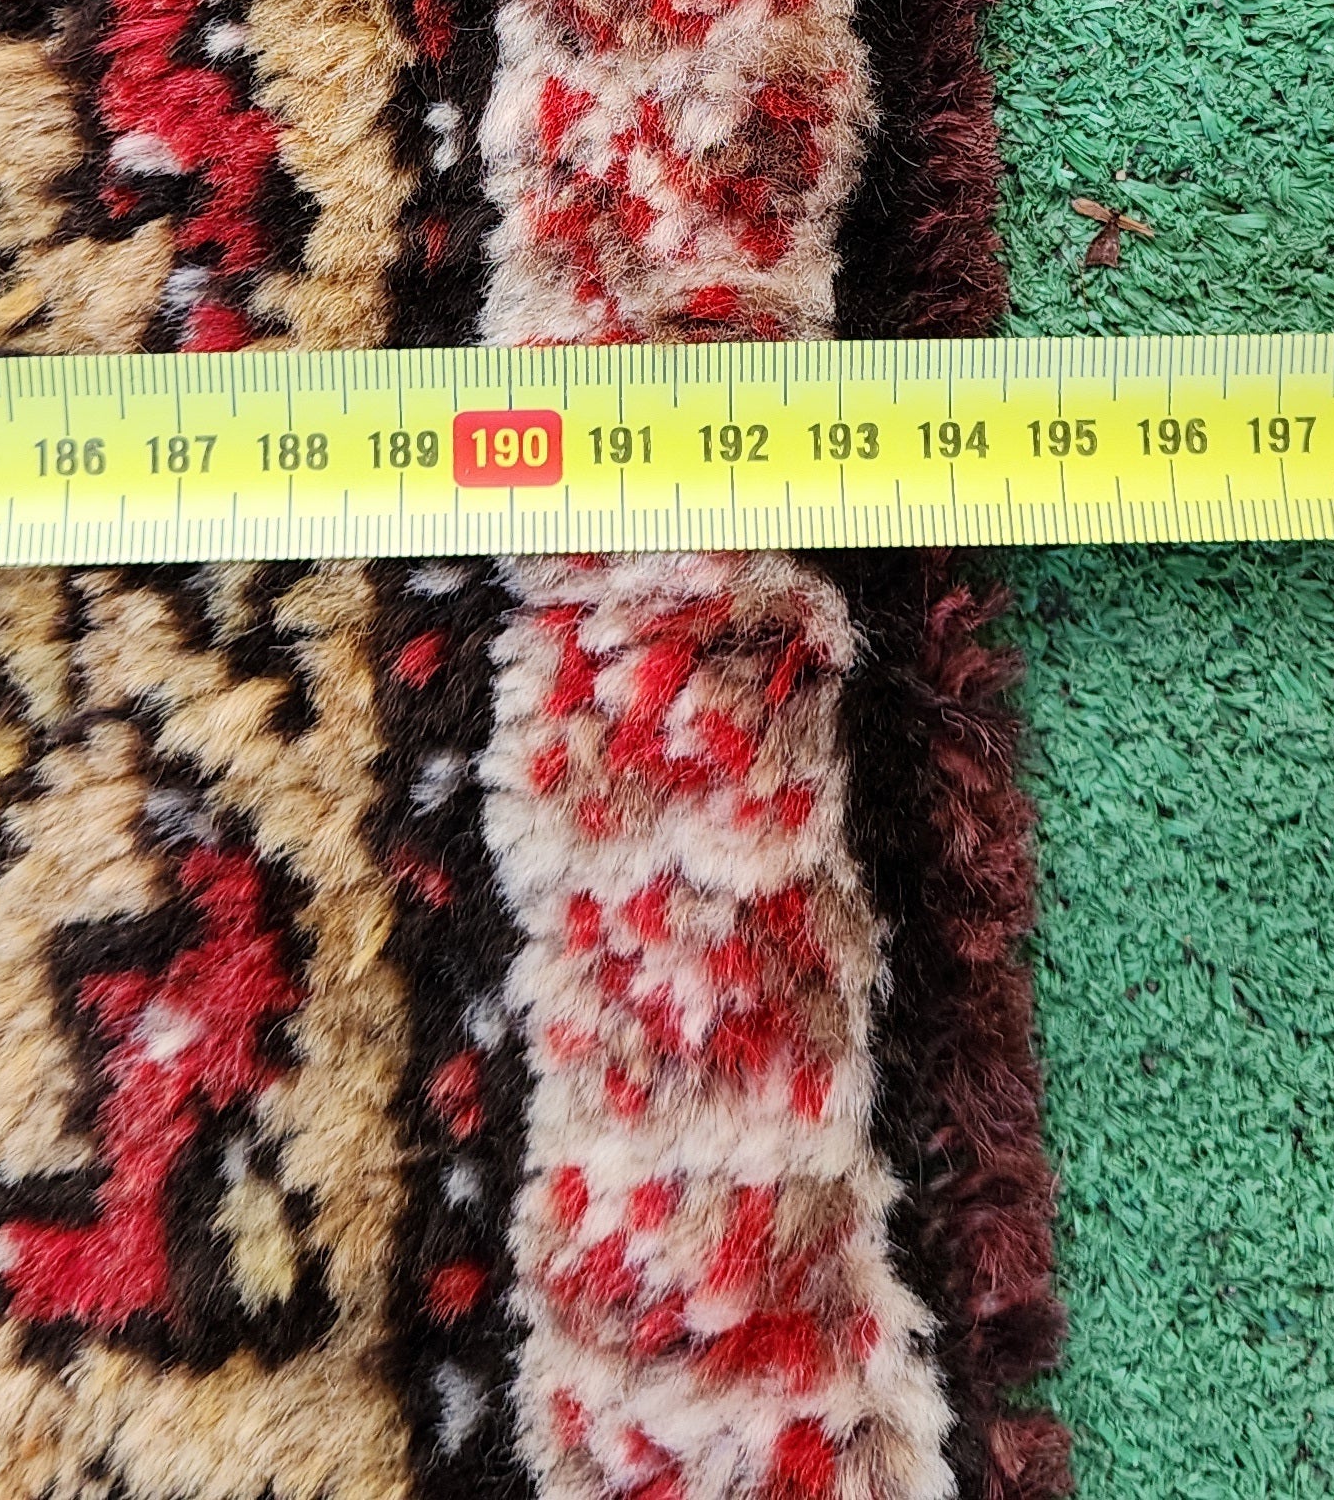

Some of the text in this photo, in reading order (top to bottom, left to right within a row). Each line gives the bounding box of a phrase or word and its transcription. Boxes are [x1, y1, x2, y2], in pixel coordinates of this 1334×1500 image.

[35, 438, 105, 476] 186
[147, 436, 217, 473] 187
[258, 433, 328, 471] 188
[368, 431, 438, 468] 189
[471, 428, 549, 468] 190
[589, 426, 651, 464] 191
[699, 425, 768, 462] 192
[808, 423, 879, 460] 193
[918, 421, 989, 458] 194
[1027, 420, 1097, 457] 195
[1138, 418, 1207, 455] 196
[1248, 417, 1316, 453] 197
